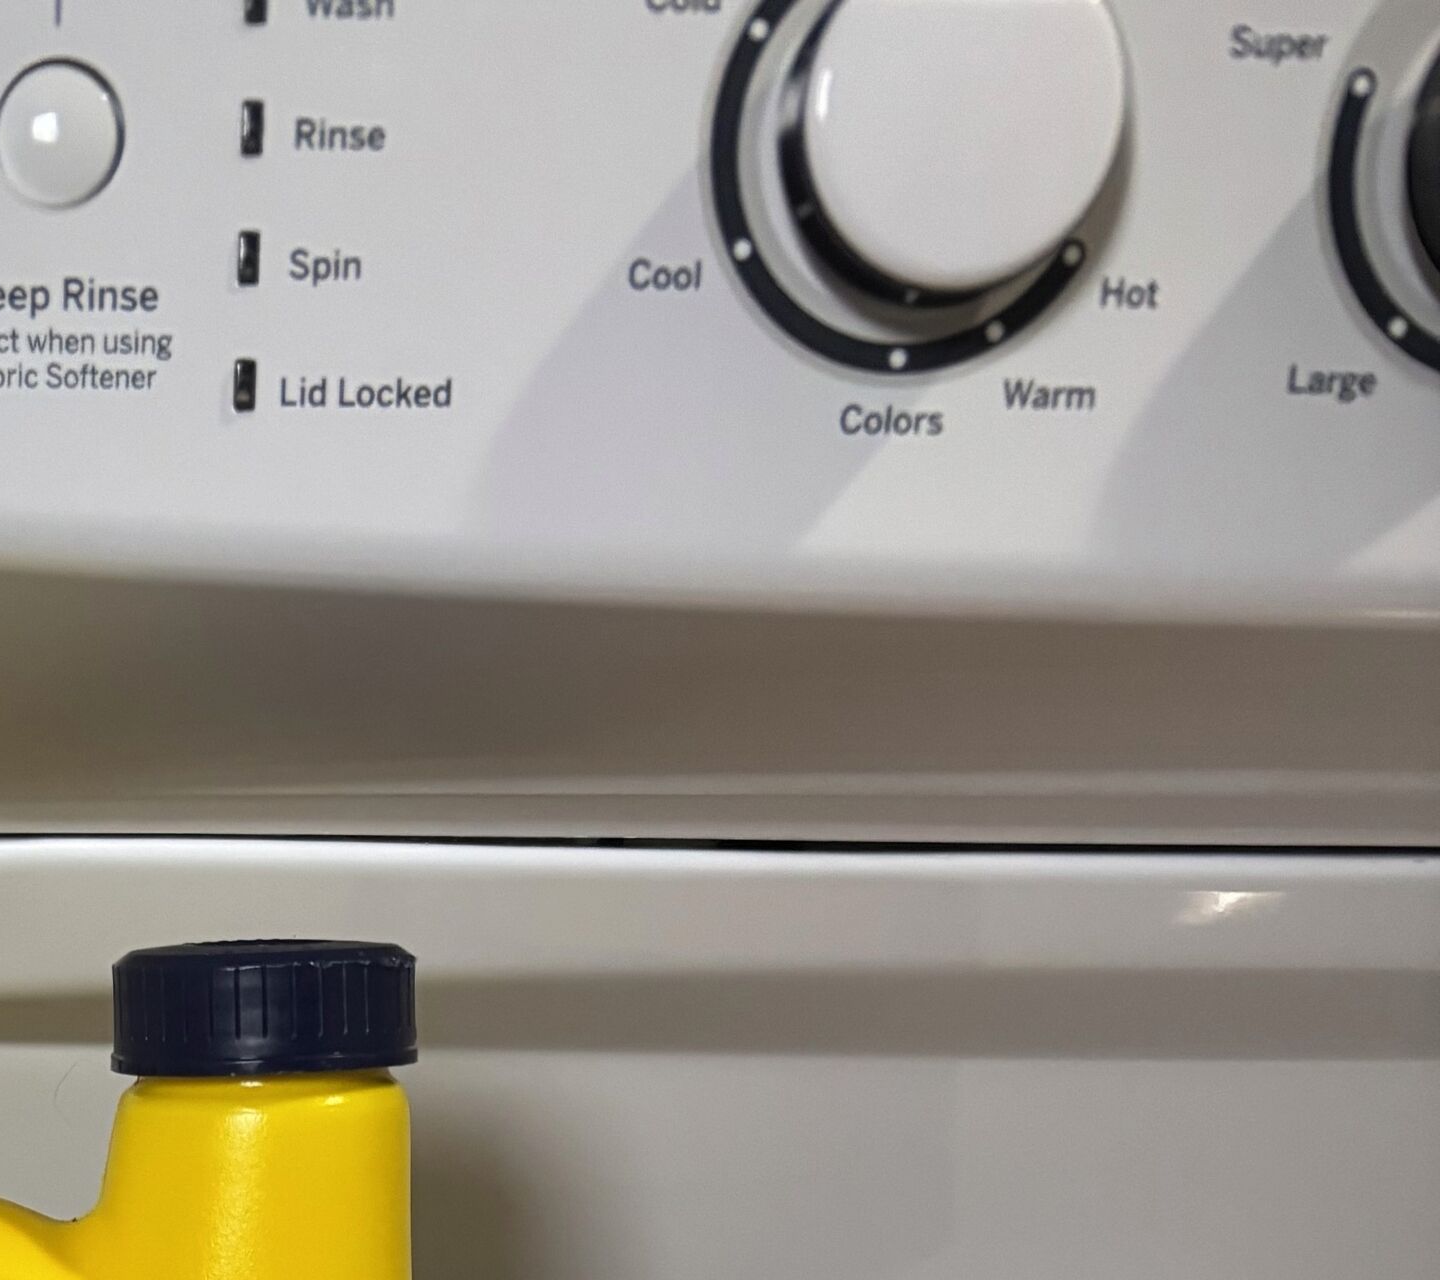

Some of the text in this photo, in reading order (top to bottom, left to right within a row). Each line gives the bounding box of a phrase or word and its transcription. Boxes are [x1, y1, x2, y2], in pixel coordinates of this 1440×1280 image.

[1229, 25, 1329, 61] Super
[294, 116, 387, 151] Rinse
[288, 247, 362, 287] Spin
[627, 258, 702, 292] Cool
[61, 277, 160, 312] Rinse
[1098, 278, 1160, 310] Hot
[26, 327, 96, 355] when
[102, 331, 173, 360] using
[44, 362, 158, 391] Softener
[279, 376, 453, 410] Lid Locked
[1287, 367, 1378, 404] Large
[1002, 379, 1097, 411] Warm
[839, 403, 945, 438] Colors
